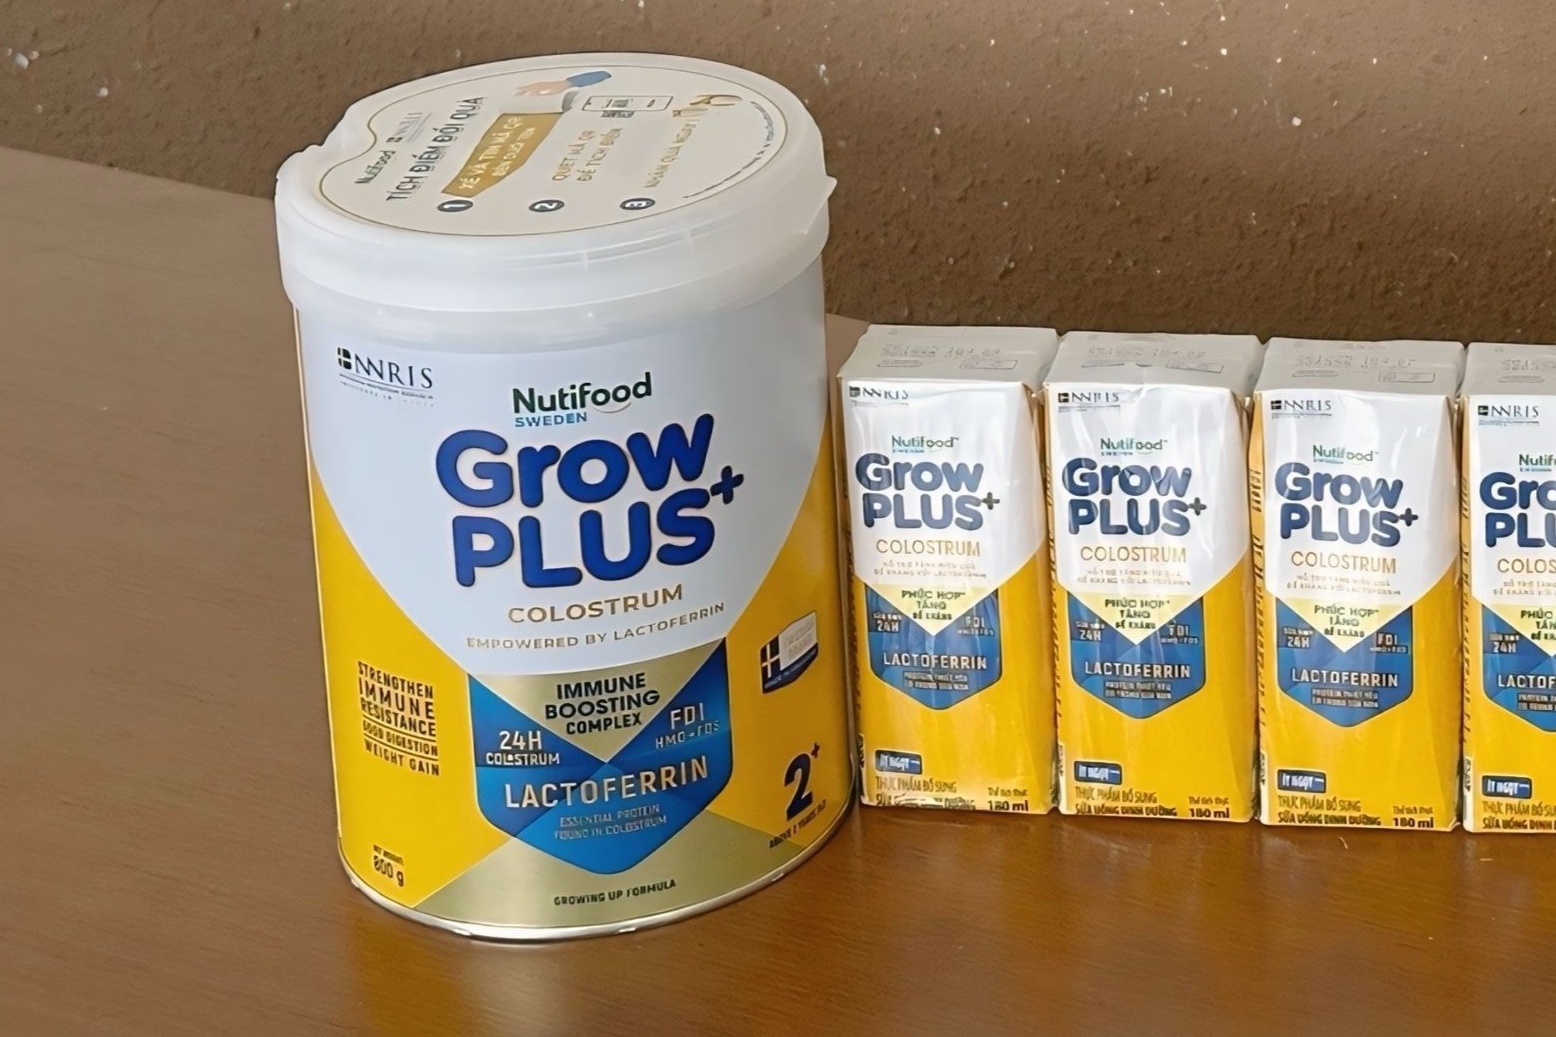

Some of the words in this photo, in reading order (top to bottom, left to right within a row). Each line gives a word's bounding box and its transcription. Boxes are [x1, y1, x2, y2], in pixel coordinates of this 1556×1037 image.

[354, 353, 434, 389] NNRIS
[512, 371, 653, 413] Nutifood
[514, 411, 588, 427] SWEDEN
[1491, 405, 1539, 417] NNRIS
[891, 435, 954, 448] Nutifood
[1100, 438, 1163, 451] Nutifood
[1312, 445, 1374, 462] Nutifood
[435, 413, 715, 509] Grow
[855, 452, 984, 493] Grow
[1062, 458, 1192, 498] Grow
[1274, 462, 1403, 510] Grow
[451, 464, 745, 588] PLUS+
[876, 539, 981, 556] COLOSTRUM
[1080, 546, 1186, 563] COLOSTRUM
[1291, 551, 1397, 574] COLOSTRUM
[508, 583, 684, 624] COLOSTRUM
[466, 635, 580, 650] EMPOWERED
[585, 632, 608, 645] BY
[613, 601, 725, 641] LACTOFERRIN
[1080, 630, 1101, 641] 24H
[883, 652, 987, 669] LACTOFERRIN
[1085, 661, 1190, 678] LACTOFERRIN
[358, 661, 433, 699] STRENGTHEN
[556, 672, 646, 701] IMMUNE
[1292, 668, 1398, 687] LACTOFERRIN
[358, 676, 435, 720] IMMUNE
[545, 689, 660, 720] BOOSTING
[360, 697, 436, 737] RESISTANCE
[566, 712, 642, 735] COMPLEX
[670, 705, 705, 730] FDI
[386, 731, 438, 757] DIGESTION
[499, 730, 542, 750] 24H
[364, 738, 403, 767] WEIGHT
[409, 758, 439, 777] GAIN
[486, 752, 560, 766] COLOSTRUM
[504, 755, 708, 808] LACTOFERRIN
[1012, 799, 1029, 811] ml
[1213, 808, 1230, 818] ml
[1417, 817, 1434, 828] ml
[554, 893, 605, 906] GROWING
[608, 890, 623, 901] UP
[626, 879, 676, 897] FORMULA
